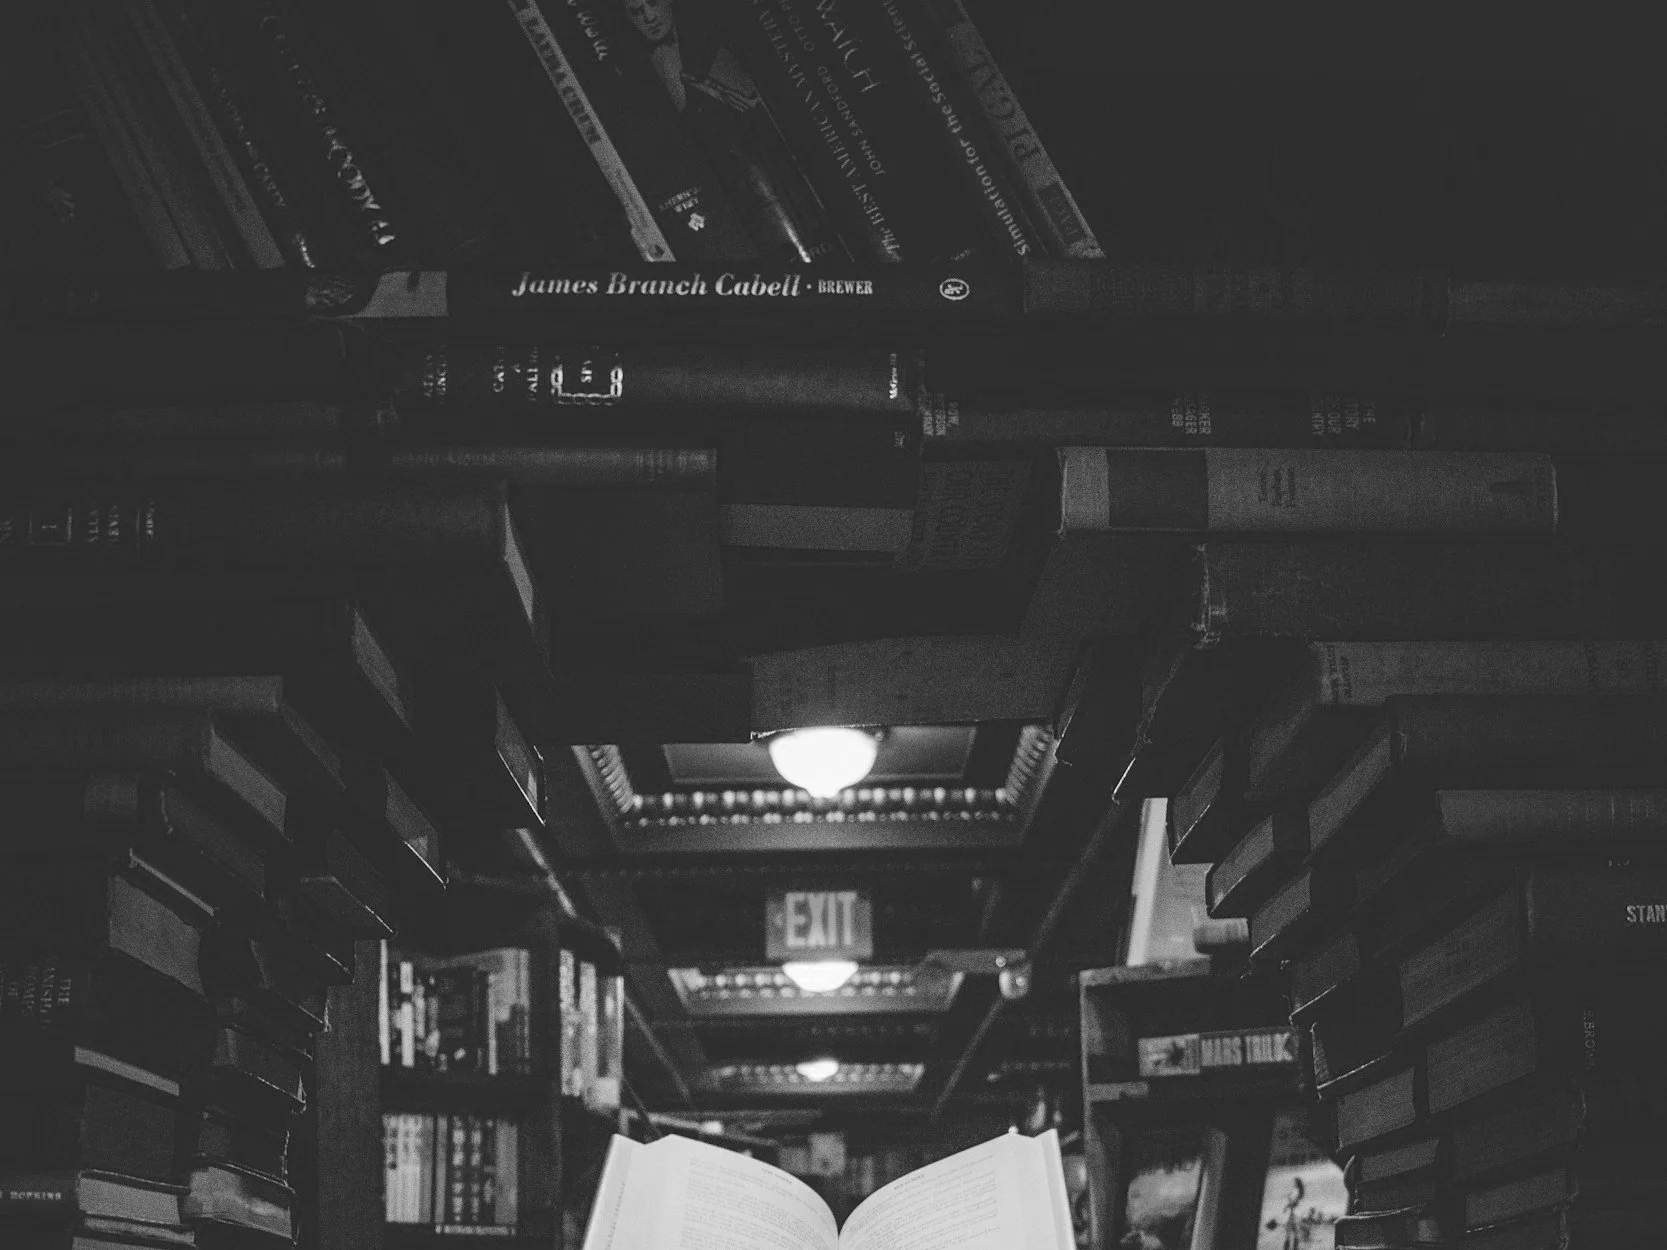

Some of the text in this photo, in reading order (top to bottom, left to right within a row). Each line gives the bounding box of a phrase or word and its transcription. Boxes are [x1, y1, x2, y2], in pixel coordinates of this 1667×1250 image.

[814, 62, 866, 138] SANDFORD
[907, 49, 949, 106] Social
[754, 6, 903, 255] The BEST AMERICAN MYSTERY
[936, 101, 965, 136] the
[856, 137, 888, 179] JOHN
[954, 134, 983, 167] for
[969, 161, 1035, 258] Simulation
[511, 272, 874, 298] James Branch Cabell BREWER
[785, 891, 858, 948] EXIT
[1626, 903, 1667, 925] STAN
